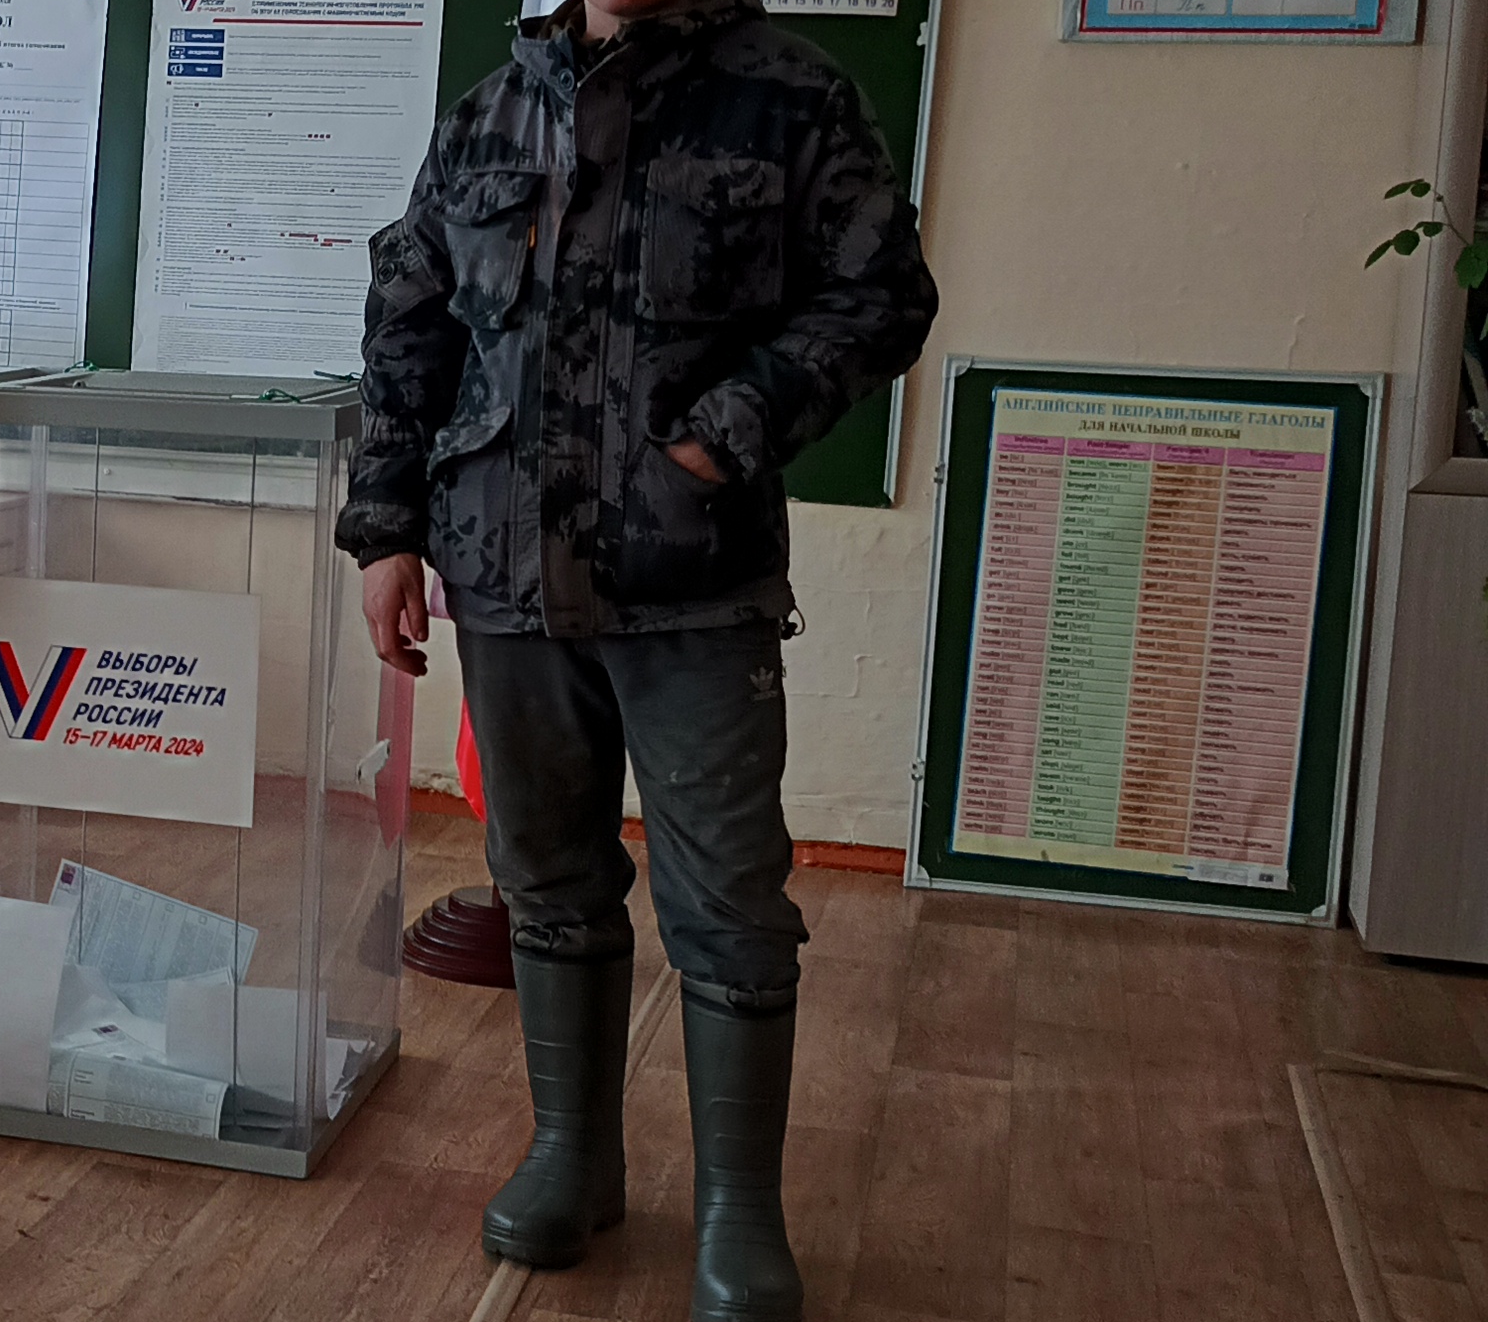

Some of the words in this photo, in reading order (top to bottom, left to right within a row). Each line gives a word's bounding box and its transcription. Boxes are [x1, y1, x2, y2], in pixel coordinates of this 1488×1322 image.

[881, 0, 894, 8] 20
[1003, 398, 1106, 416] АНГЛИЙСКИЕ
[1113, 403, 1242, 424] НЕПРАВИЛЬНЫЕ
[1248, 407, 1326, 428] ГЛАГОЛЫ
[1078, 420, 1105, 432] ДЛЯ
[1110, 422, 1186, 437] НАЧАЛЬНОЙ
[1191, 426, 1240, 439] ШКОЛЫ
[97, 650, 198, 676] ВЫБОРЫ
[85, 676, 226, 707] ПРЕЗИДЕНТА
[73, 702, 163, 728] РОССИИ
[108, 732, 163, 753] МАРТА
[164, 737, 204, 757] 2024
